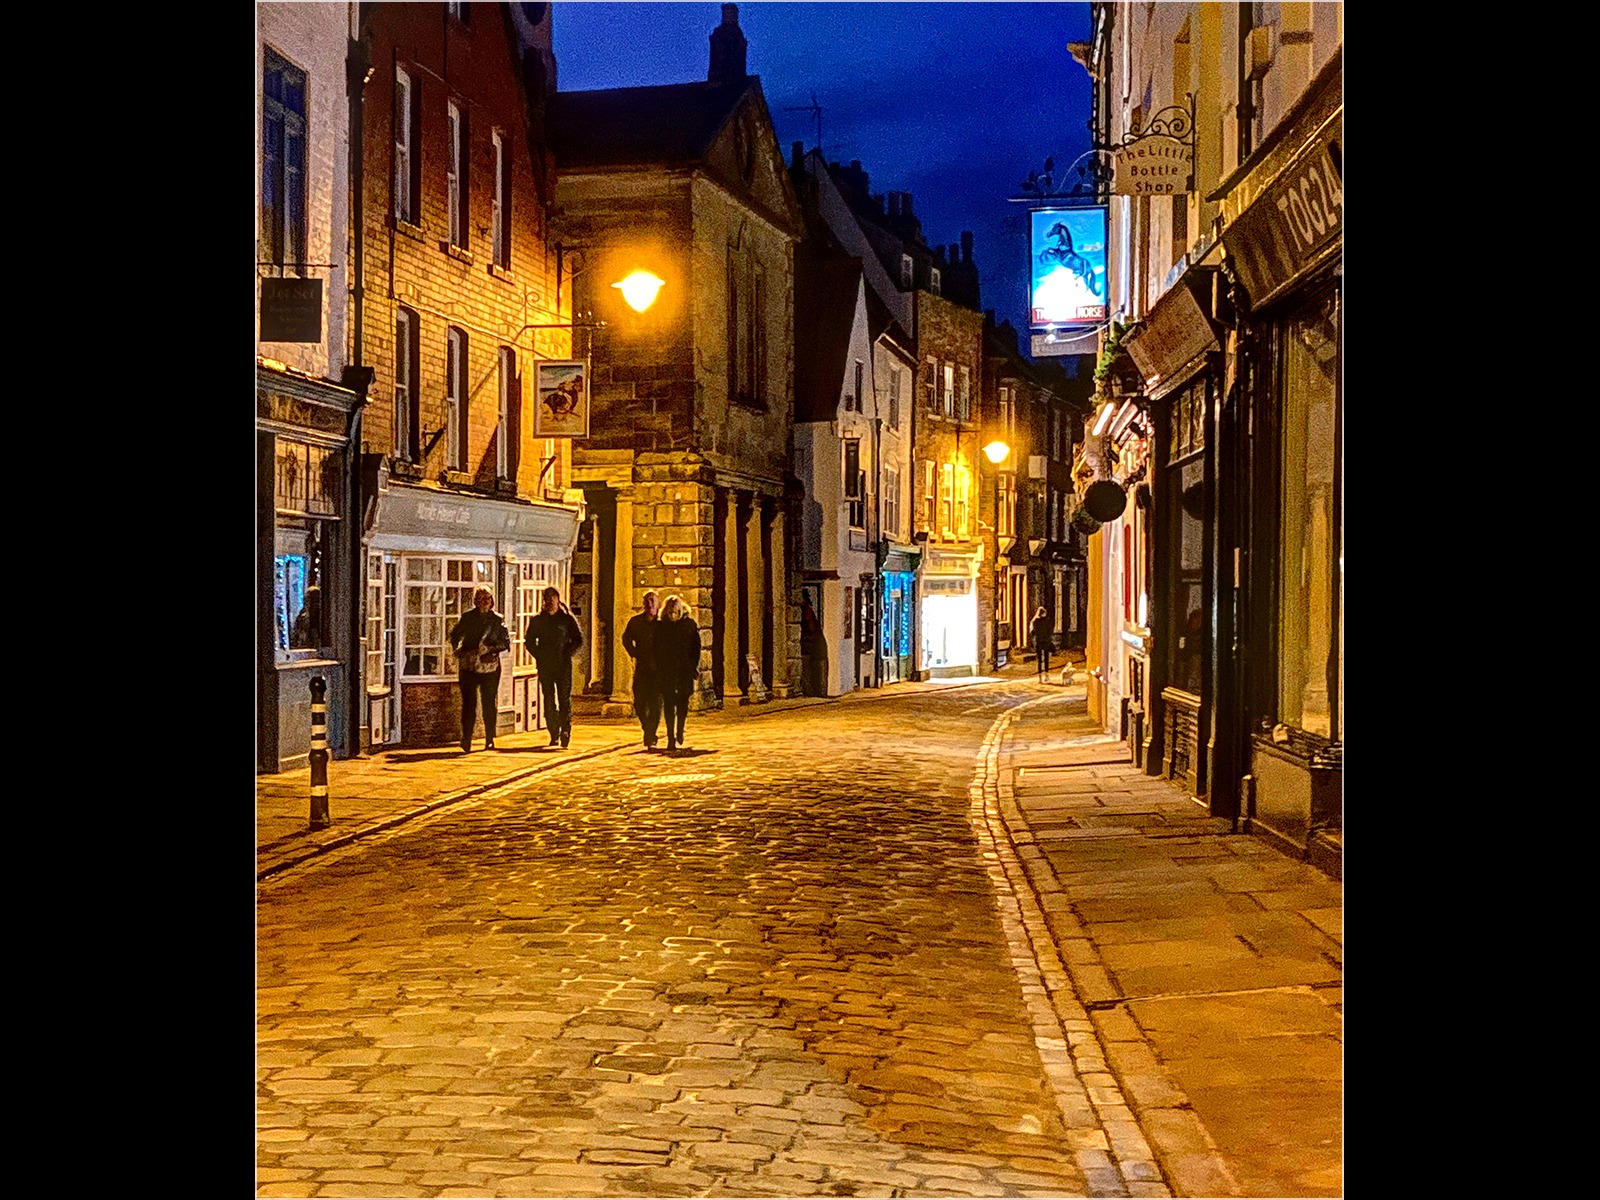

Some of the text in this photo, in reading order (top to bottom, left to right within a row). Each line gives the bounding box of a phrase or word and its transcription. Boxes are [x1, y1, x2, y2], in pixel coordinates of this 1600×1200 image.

[1116, 145, 1192, 164] The Little
[1130, 165, 1178, 176] Bottle
[1135, 181, 1174, 194] Shop
[1276, 155, 1342, 252] TOG24
